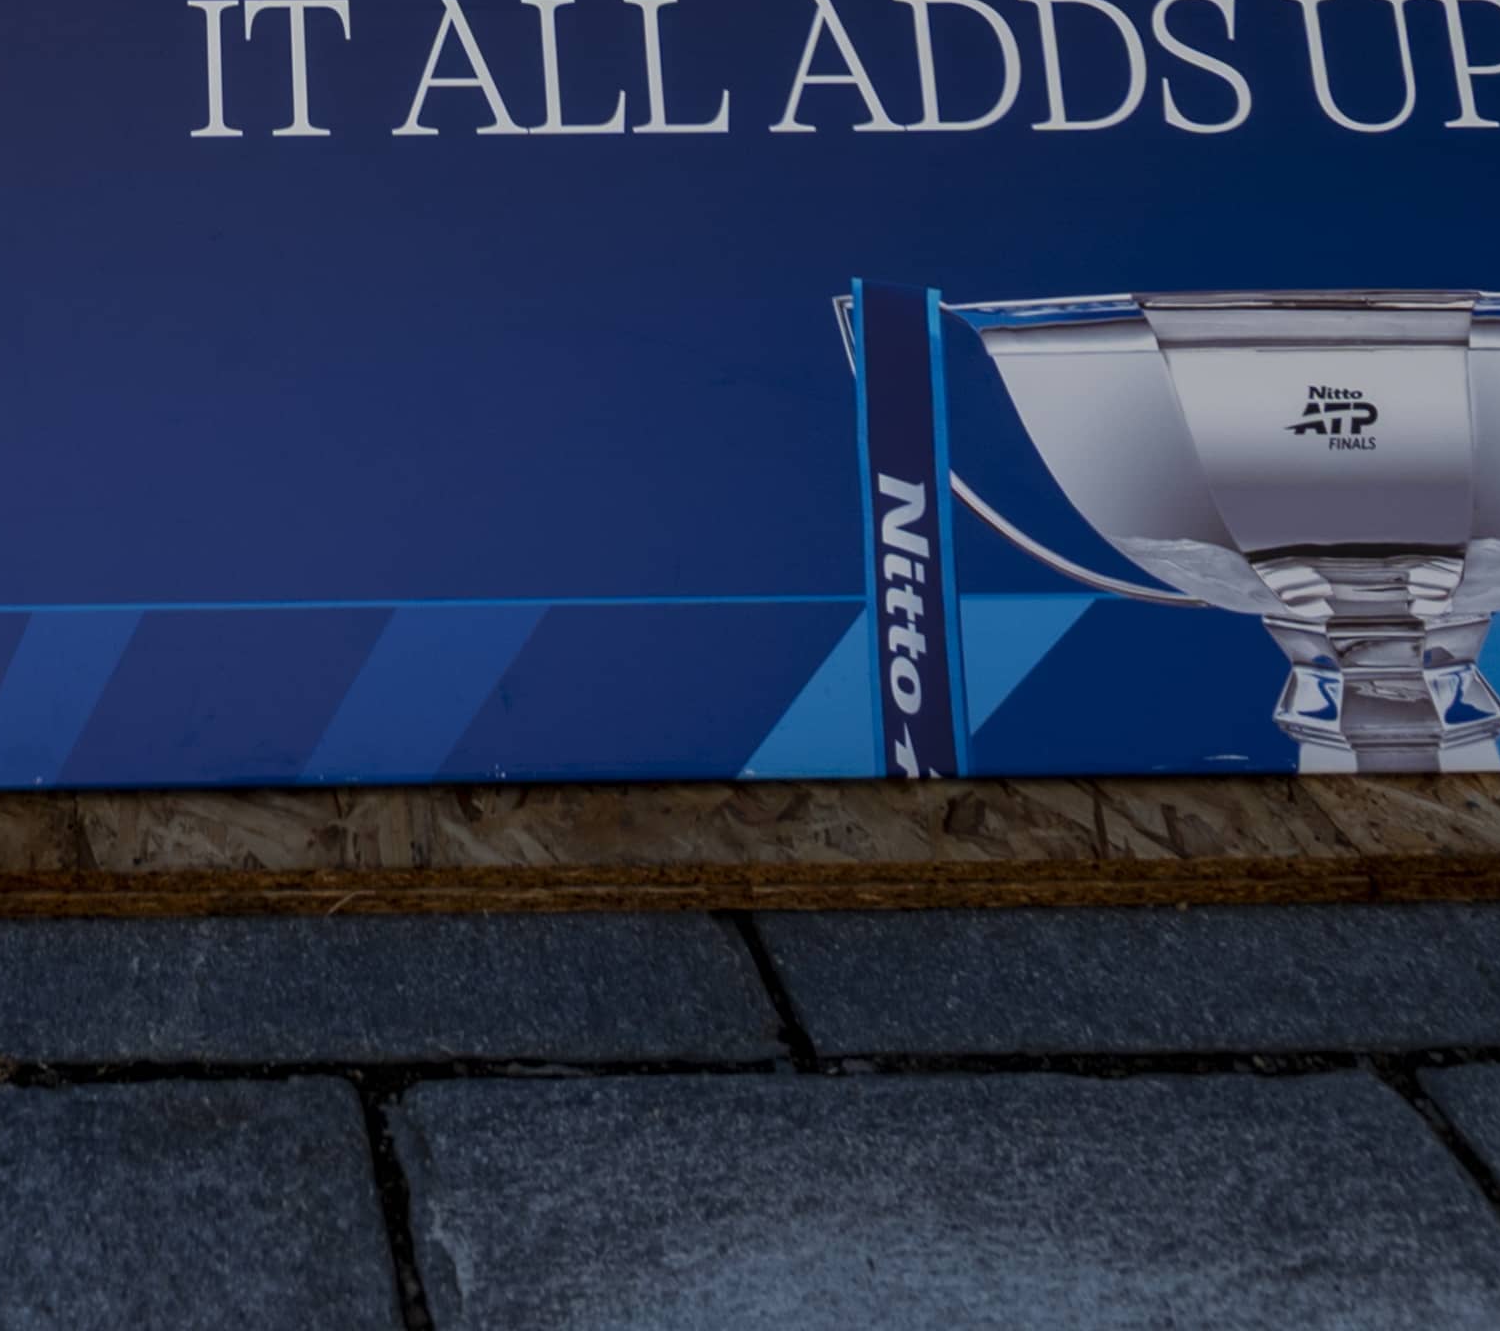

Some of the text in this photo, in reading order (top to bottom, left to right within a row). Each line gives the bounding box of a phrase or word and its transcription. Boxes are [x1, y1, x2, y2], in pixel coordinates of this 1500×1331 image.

[1308, 385, 1363, 400] Nitto
[1283, 402, 1379, 435] ATP
[1328, 437, 1377, 451] FINALS
[877, 472, 931, 715] Nitto
